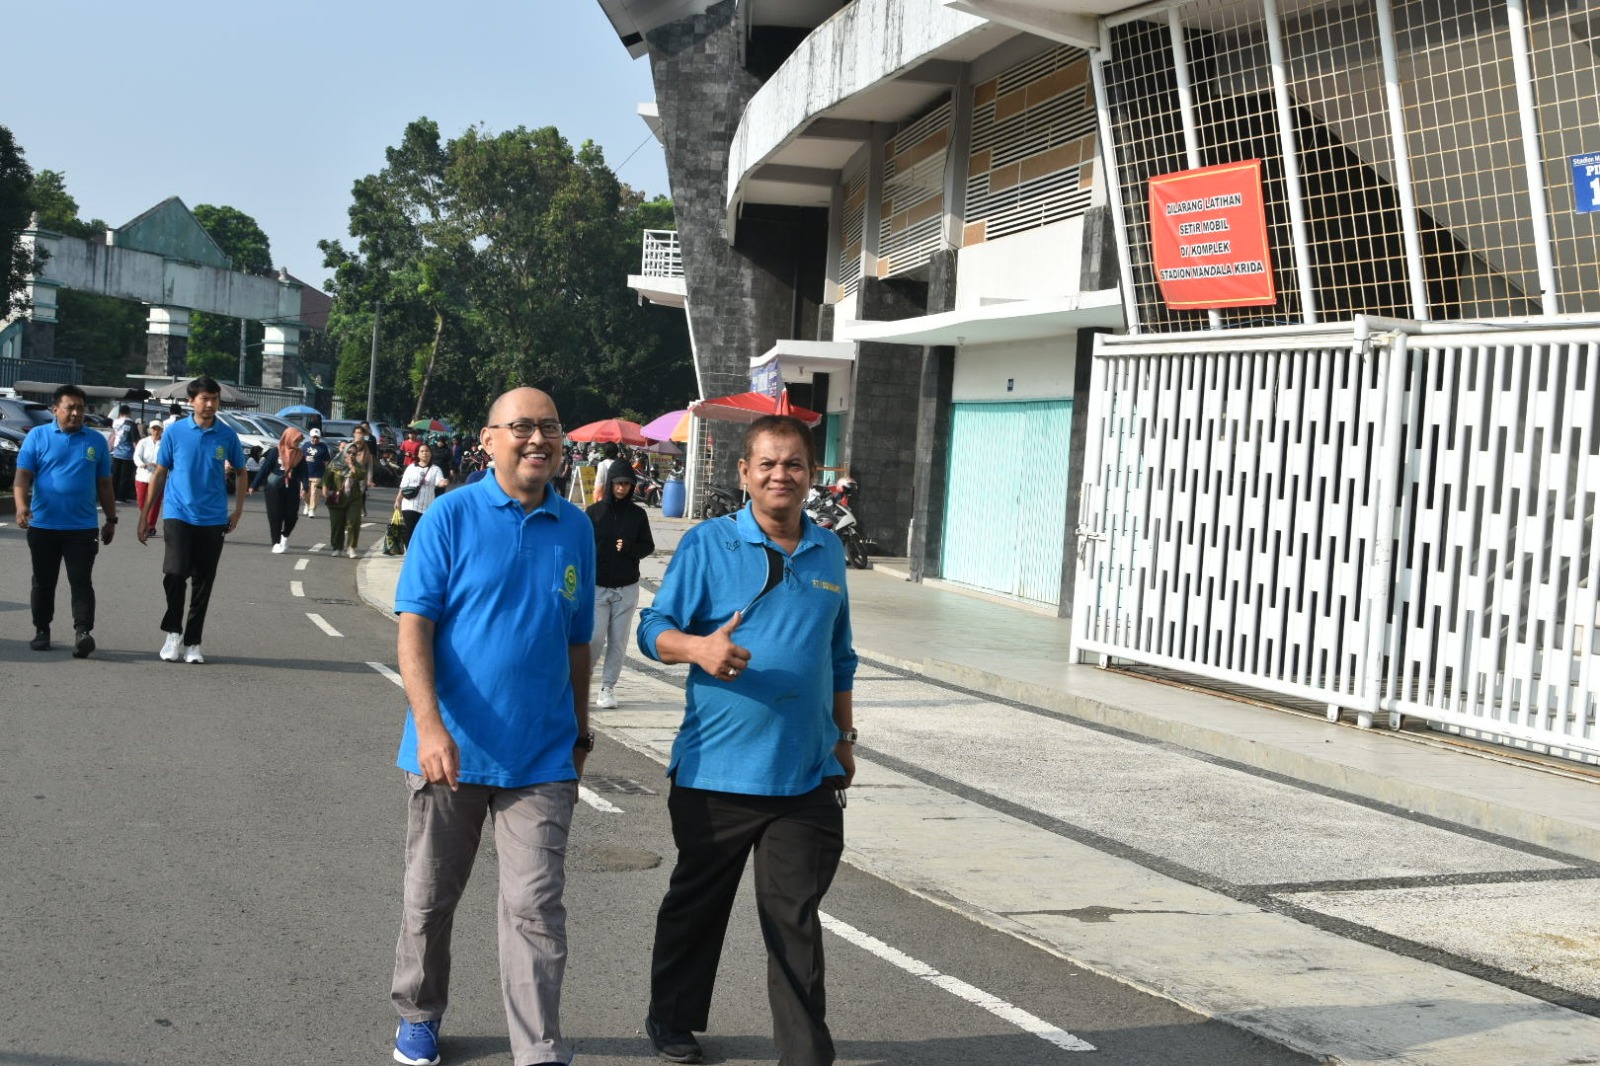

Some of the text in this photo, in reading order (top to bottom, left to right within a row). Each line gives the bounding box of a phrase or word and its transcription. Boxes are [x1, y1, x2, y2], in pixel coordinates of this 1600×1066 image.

[1572, 157, 1594, 165] Stadion
[1585, 165, 1600, 176] PI
[1166, 193, 1242, 216] DILARANG LATIHAN
[1179, 218, 1229, 236] SETIR MOBIL
[1180, 241, 1231, 257] DI KOMPLEK
[1159, 260, 1264, 281] STADION MANDALA KRIDA
